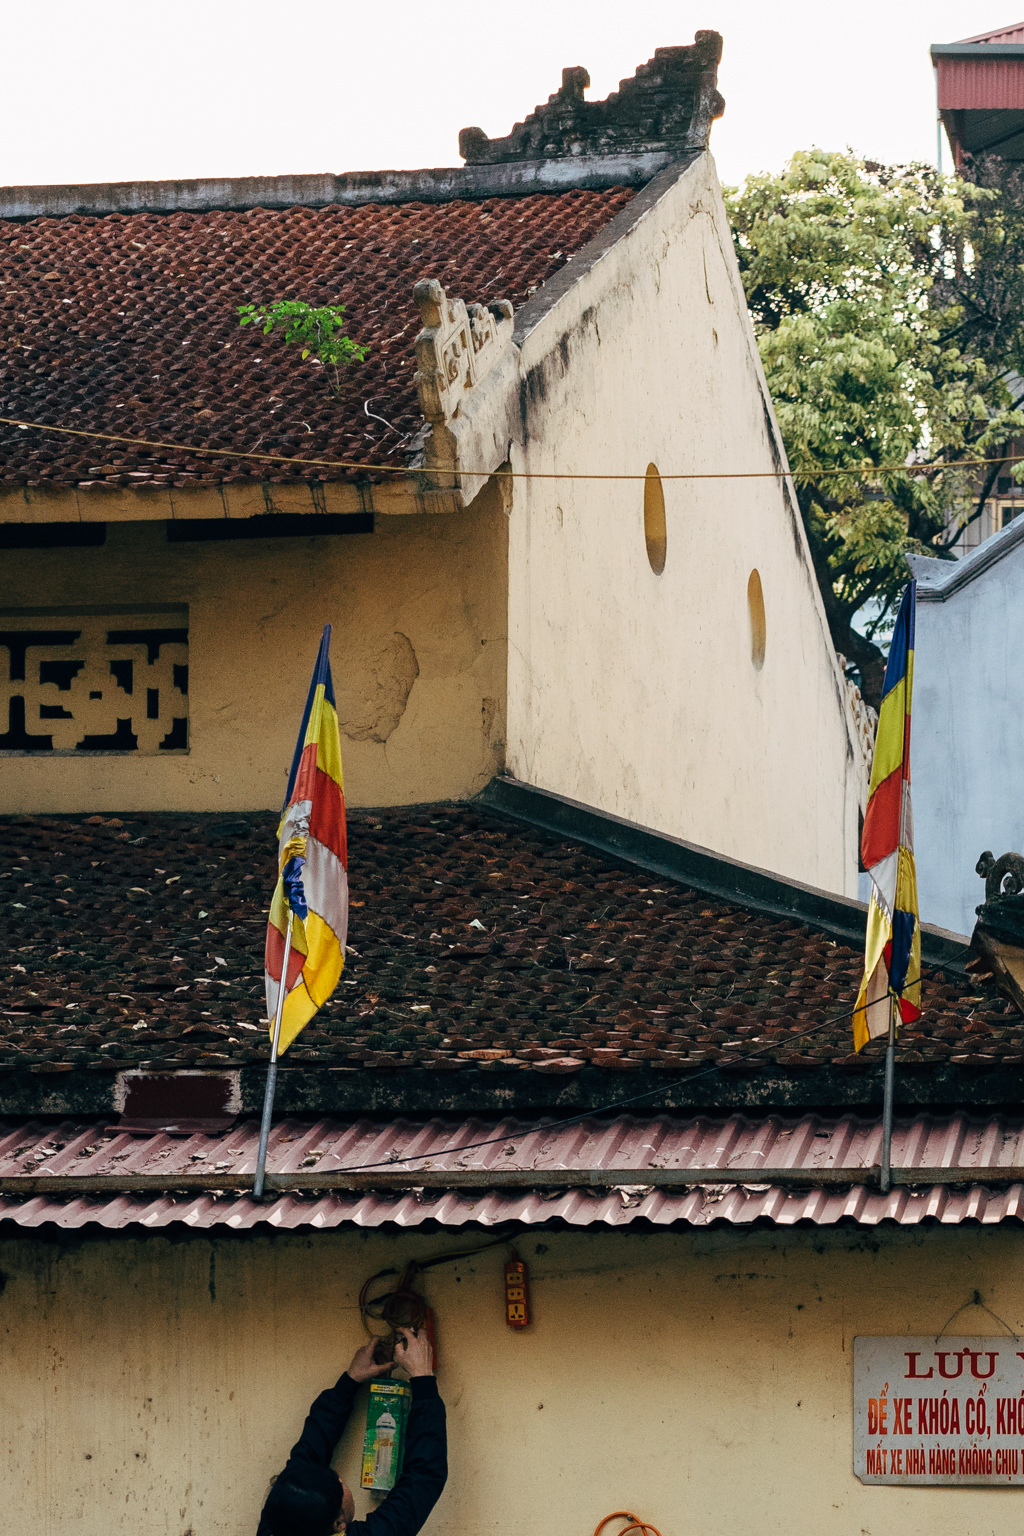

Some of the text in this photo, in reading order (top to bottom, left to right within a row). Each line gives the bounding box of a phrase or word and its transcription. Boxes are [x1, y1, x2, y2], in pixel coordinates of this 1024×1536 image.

[904, 1347, 999, 1379] LƯU
[868, 1382, 889, 1435] ĐỂ
[893, 1398, 912, 1435] XE
[918, 1390, 960, 1435] KHÓA
[966, 1382, 991, 1439] CỔ,
[866, 1440, 887, 1475] MẤT
[890, 1449, 902, 1475] XE
[905, 1443, 926, 1475] NHÀ
[929, 1443, 956, 1475] HÀNG
[958, 1444, 993, 1475] KHÔNG
[995, 1449, 1018, 1481] CHỊU
